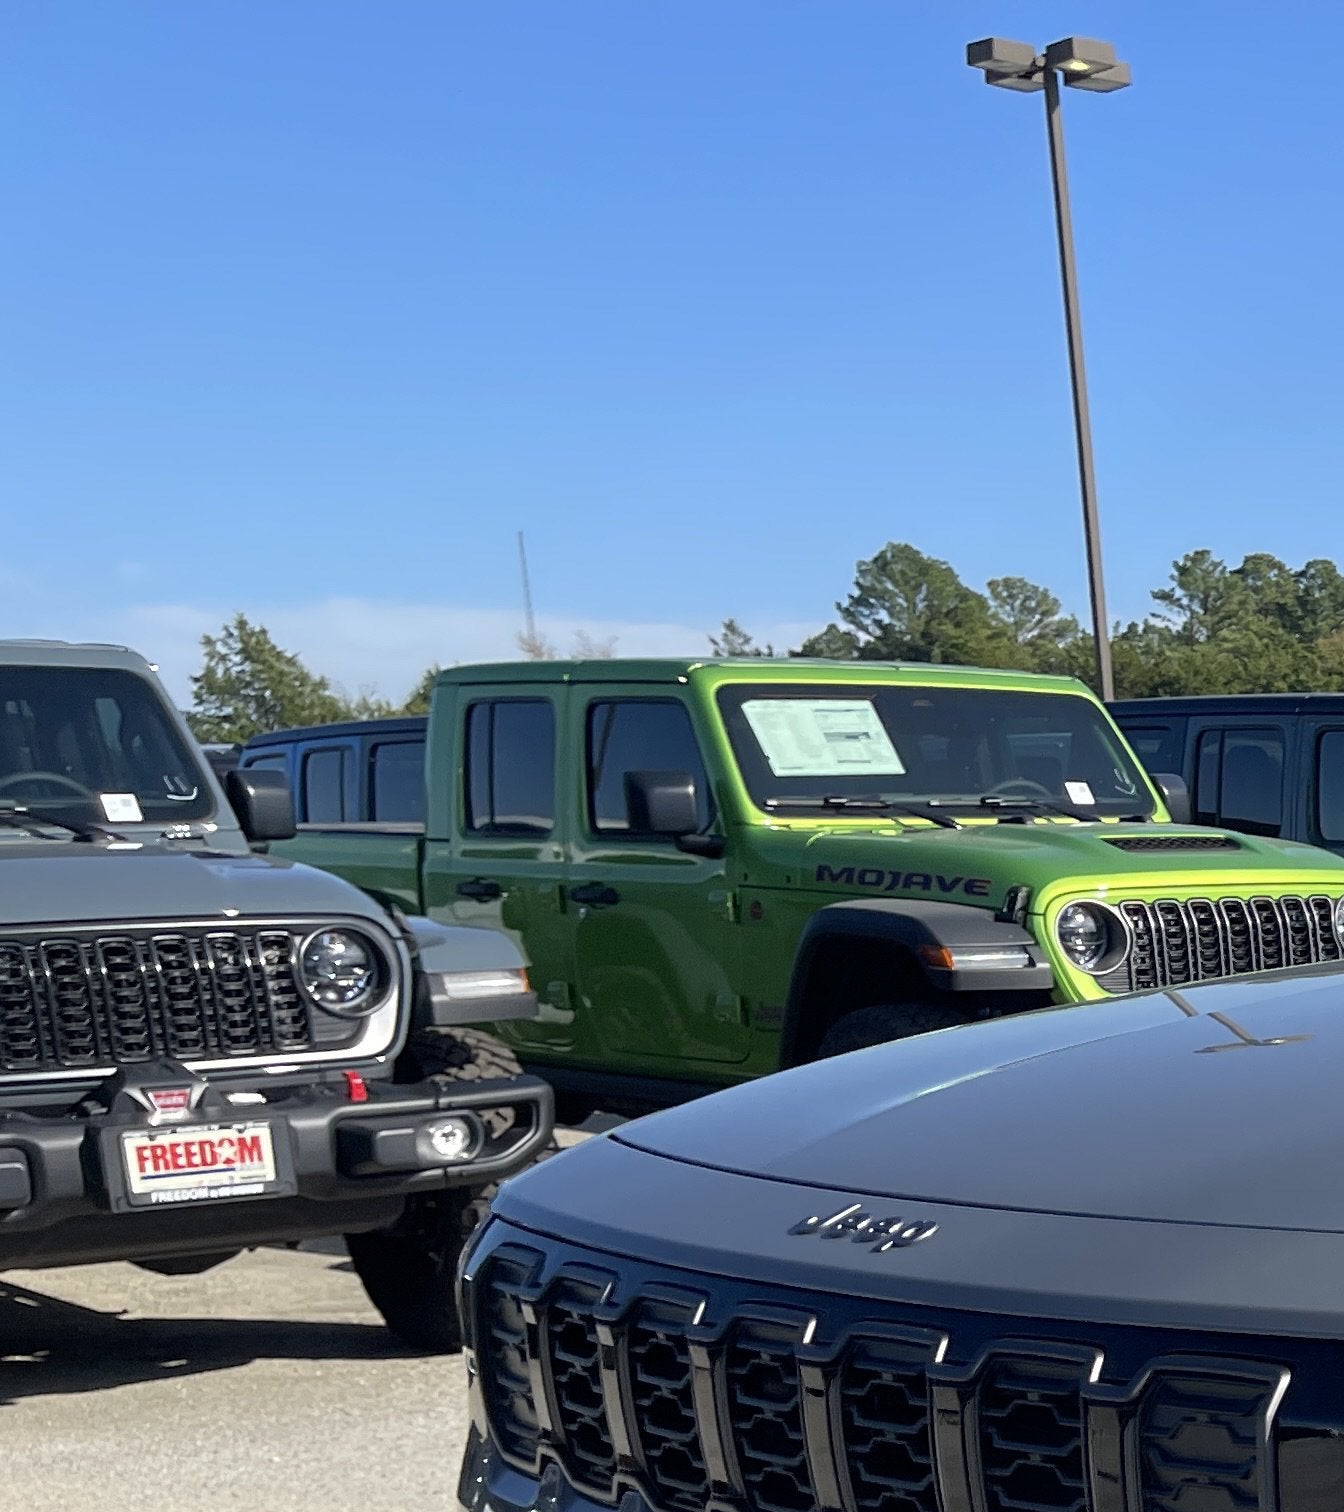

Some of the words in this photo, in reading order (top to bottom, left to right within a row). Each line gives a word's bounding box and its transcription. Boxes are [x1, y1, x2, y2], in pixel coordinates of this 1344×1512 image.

[815, 864, 992, 897] MOJAVE
[135, 1135, 263, 1174] FREEDOM
[787, 1203, 940, 1253] Jeep
